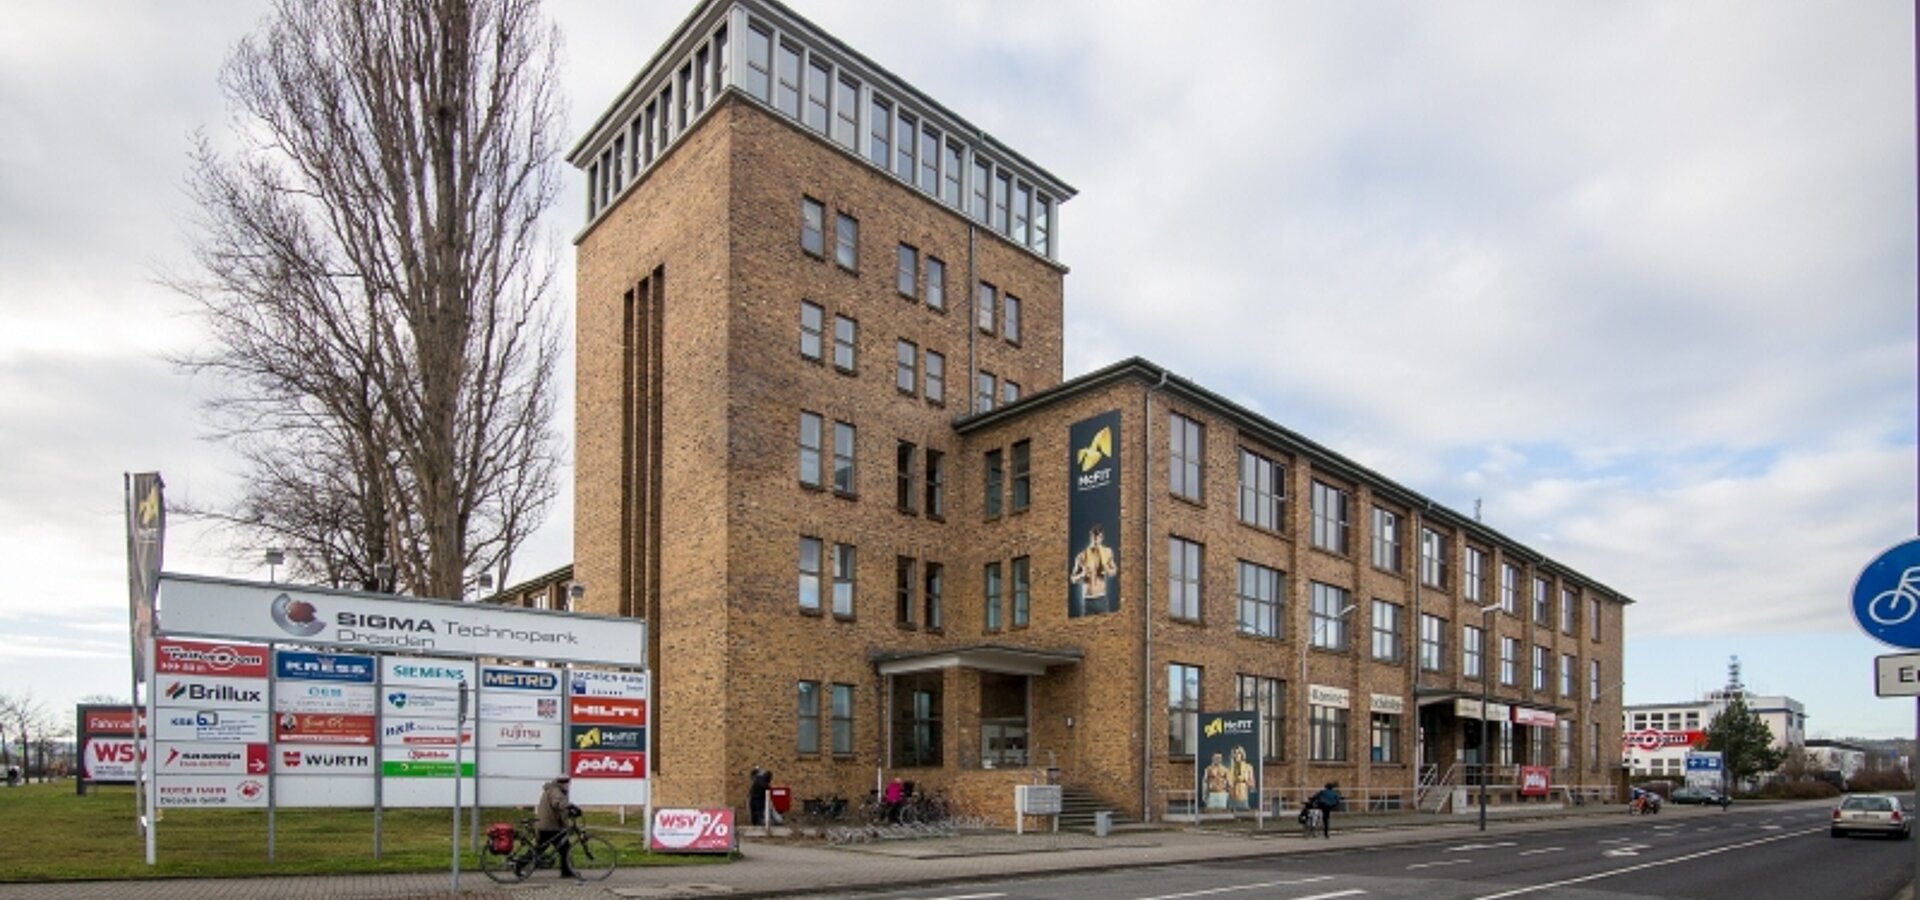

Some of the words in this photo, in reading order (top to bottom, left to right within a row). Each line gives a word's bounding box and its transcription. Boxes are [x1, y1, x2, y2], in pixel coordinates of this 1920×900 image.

[336, 611, 436, 633] SIGMA
[442, 620, 579, 644] Technopark
[337, 628, 436, 648] Dresden
[393, 664, 465, 680] SIEMENS
[485, 671, 554, 688] METRO
[189, 683, 261, 703] Brillux
[573, 704, 639, 717] HILTI
[305, 753, 369, 768] WÜRTH
[660, 814, 698, 828] WSV
